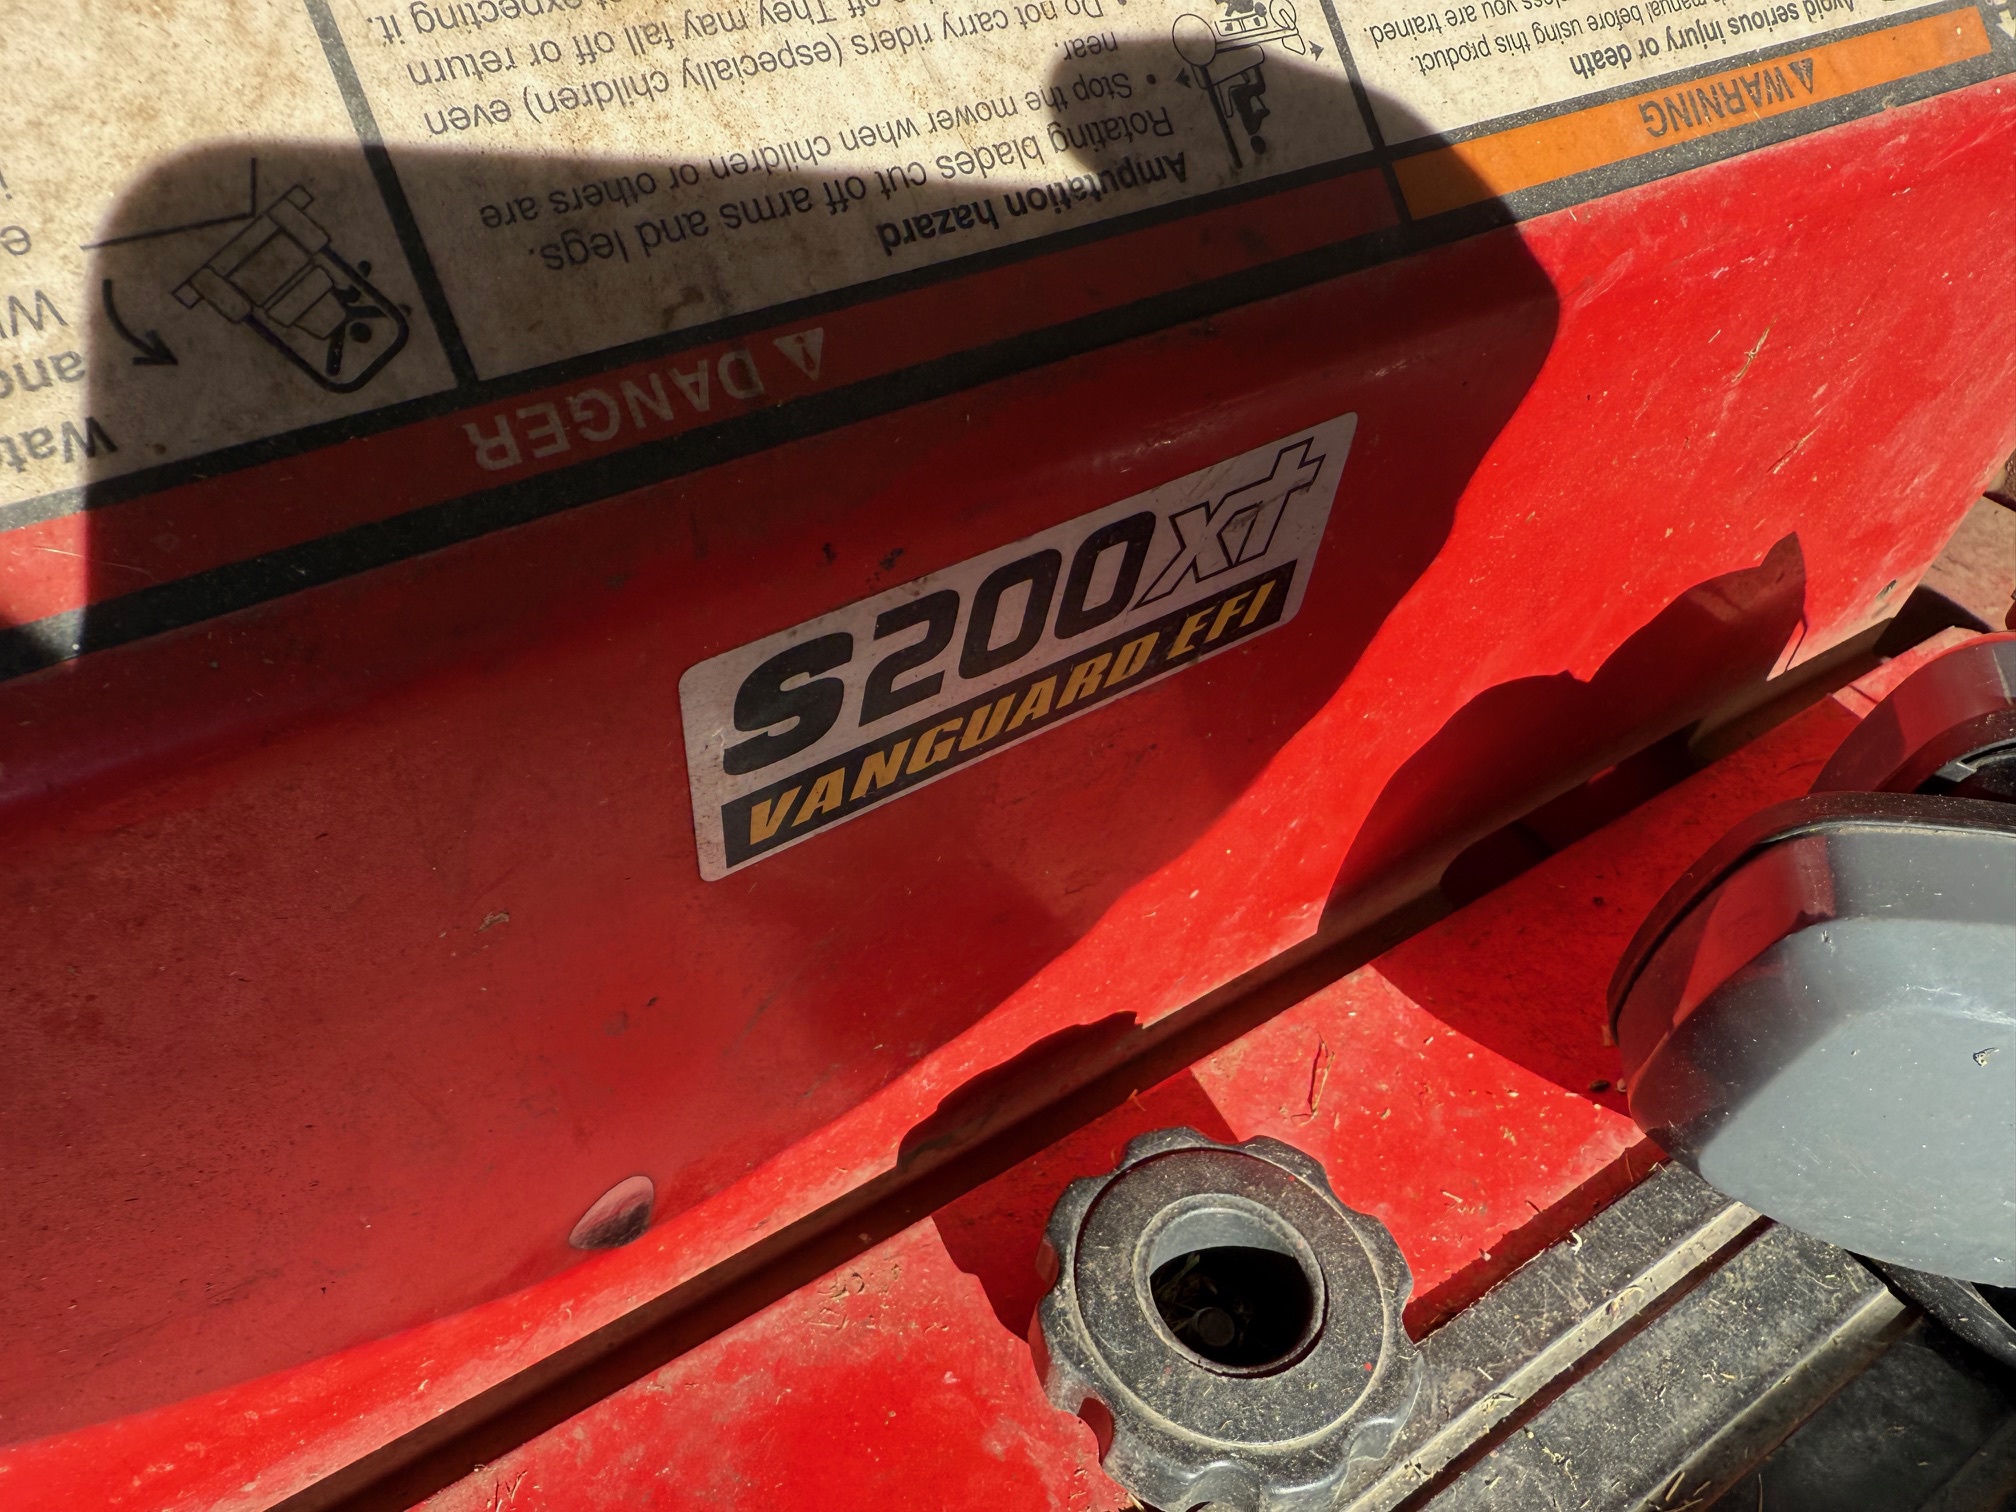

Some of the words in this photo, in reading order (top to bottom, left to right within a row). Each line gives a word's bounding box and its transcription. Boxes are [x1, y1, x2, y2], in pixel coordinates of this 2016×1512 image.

[684, 9, 748, 40] may
[760, 0, 837, 27] They
[942, 9, 1009, 40] carry
[1014, 0, 1058, 30] not
[1065, 0, 1104, 19] Do
[1445, 5, 1477, 29] are
[1481, 0, 1518, 19] you
[1587, 4, 1644, 33] before
[1727, 2, 1800, 36] serious
[366, 14, 406, 45] it.
[624, 21, 675, 56] fall
[850, 23, 933, 56] riders
[1054, 31, 1118, 62] near.
[1363, 13, 1442, 49] trained.
[1495, 31, 1530, 56] this
[1531, 19, 1583, 46] using
[1666, 19, 1726, 53] injury
[529, 40, 562, 67] or
[572, 31, 615, 66] off
[683, 33, 843, 92] (especially
[1410, 34, 1492, 77] product.
[1569, 43, 1632, 80] death
[1637, 37, 1660, 60] or
[406, 47, 517, 86] return
[523, 70, 670, 124] children)
[1024, 85, 1067, 116] the
[1072, 73, 1132, 103] Stop
[1637, 66, 1795, 138] WARNING
[423, 99, 512, 135] even
[928, 95, 1018, 134] mower
[1047, 106, 1174, 155] Rotating
[838, 117, 920, 152] when
[708, 135, 831, 181] children
[936, 135, 1045, 179] blades
[548, 172, 657, 216] others
[668, 163, 699, 191] or
[874, 161, 927, 201] cut
[1003, 151, 1187, 218] Amputation
[479, 196, 539, 230] are
[718, 187, 813, 230] arms
[822, 176, 866, 216] off
[634, 210, 709, 258] and
[875, 199, 999, 257] hazard
[528, 229, 629, 271] legs.
[462, 348, 764, 471] DANGER
[0, 416, 118, 473] Wat
[750, 630, 1161, 845] VANGUARD
[1166, 579, 1277, 659] EFI
